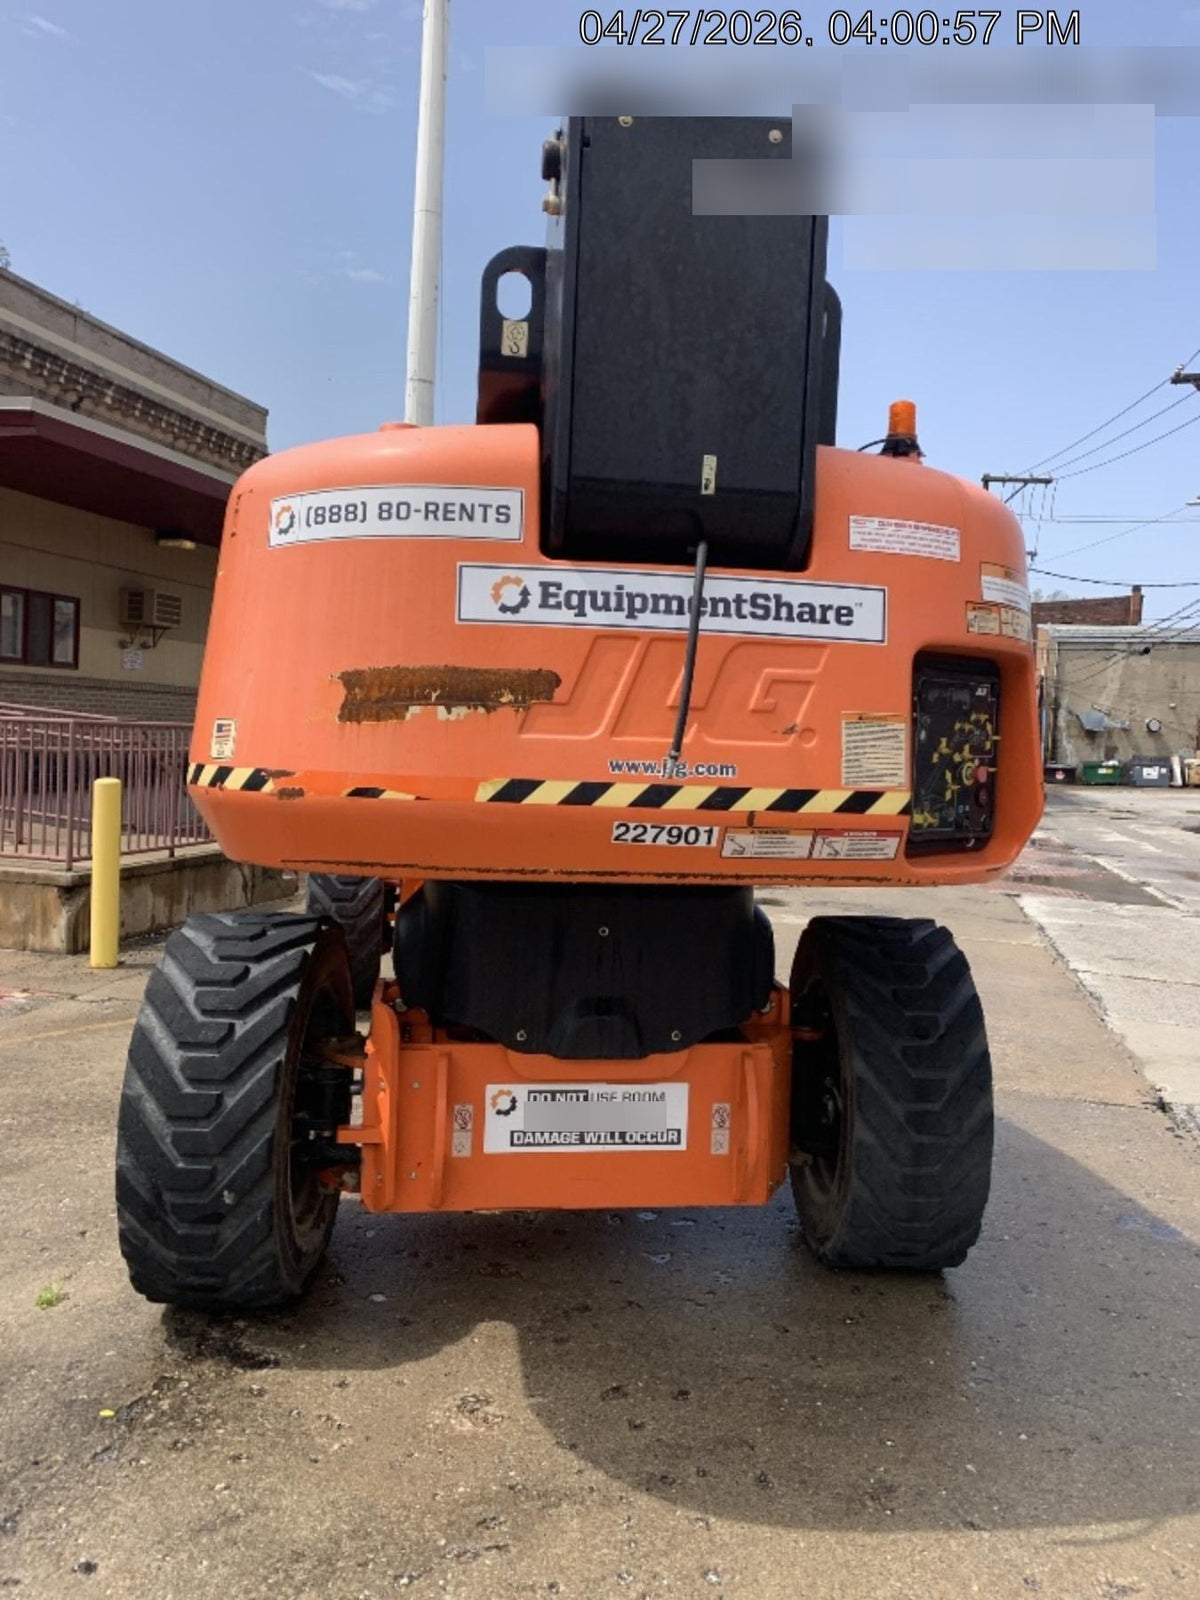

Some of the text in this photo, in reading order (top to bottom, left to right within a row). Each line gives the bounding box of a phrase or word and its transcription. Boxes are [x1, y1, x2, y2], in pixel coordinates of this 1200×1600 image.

[305, 500, 512, 528] (888) 80-RENTS
[609, 758, 738, 779] www.jg.com
[612, 822, 716, 846] 227901
[512, 1130, 680, 1145] DAMAGE WILL OCCUR
